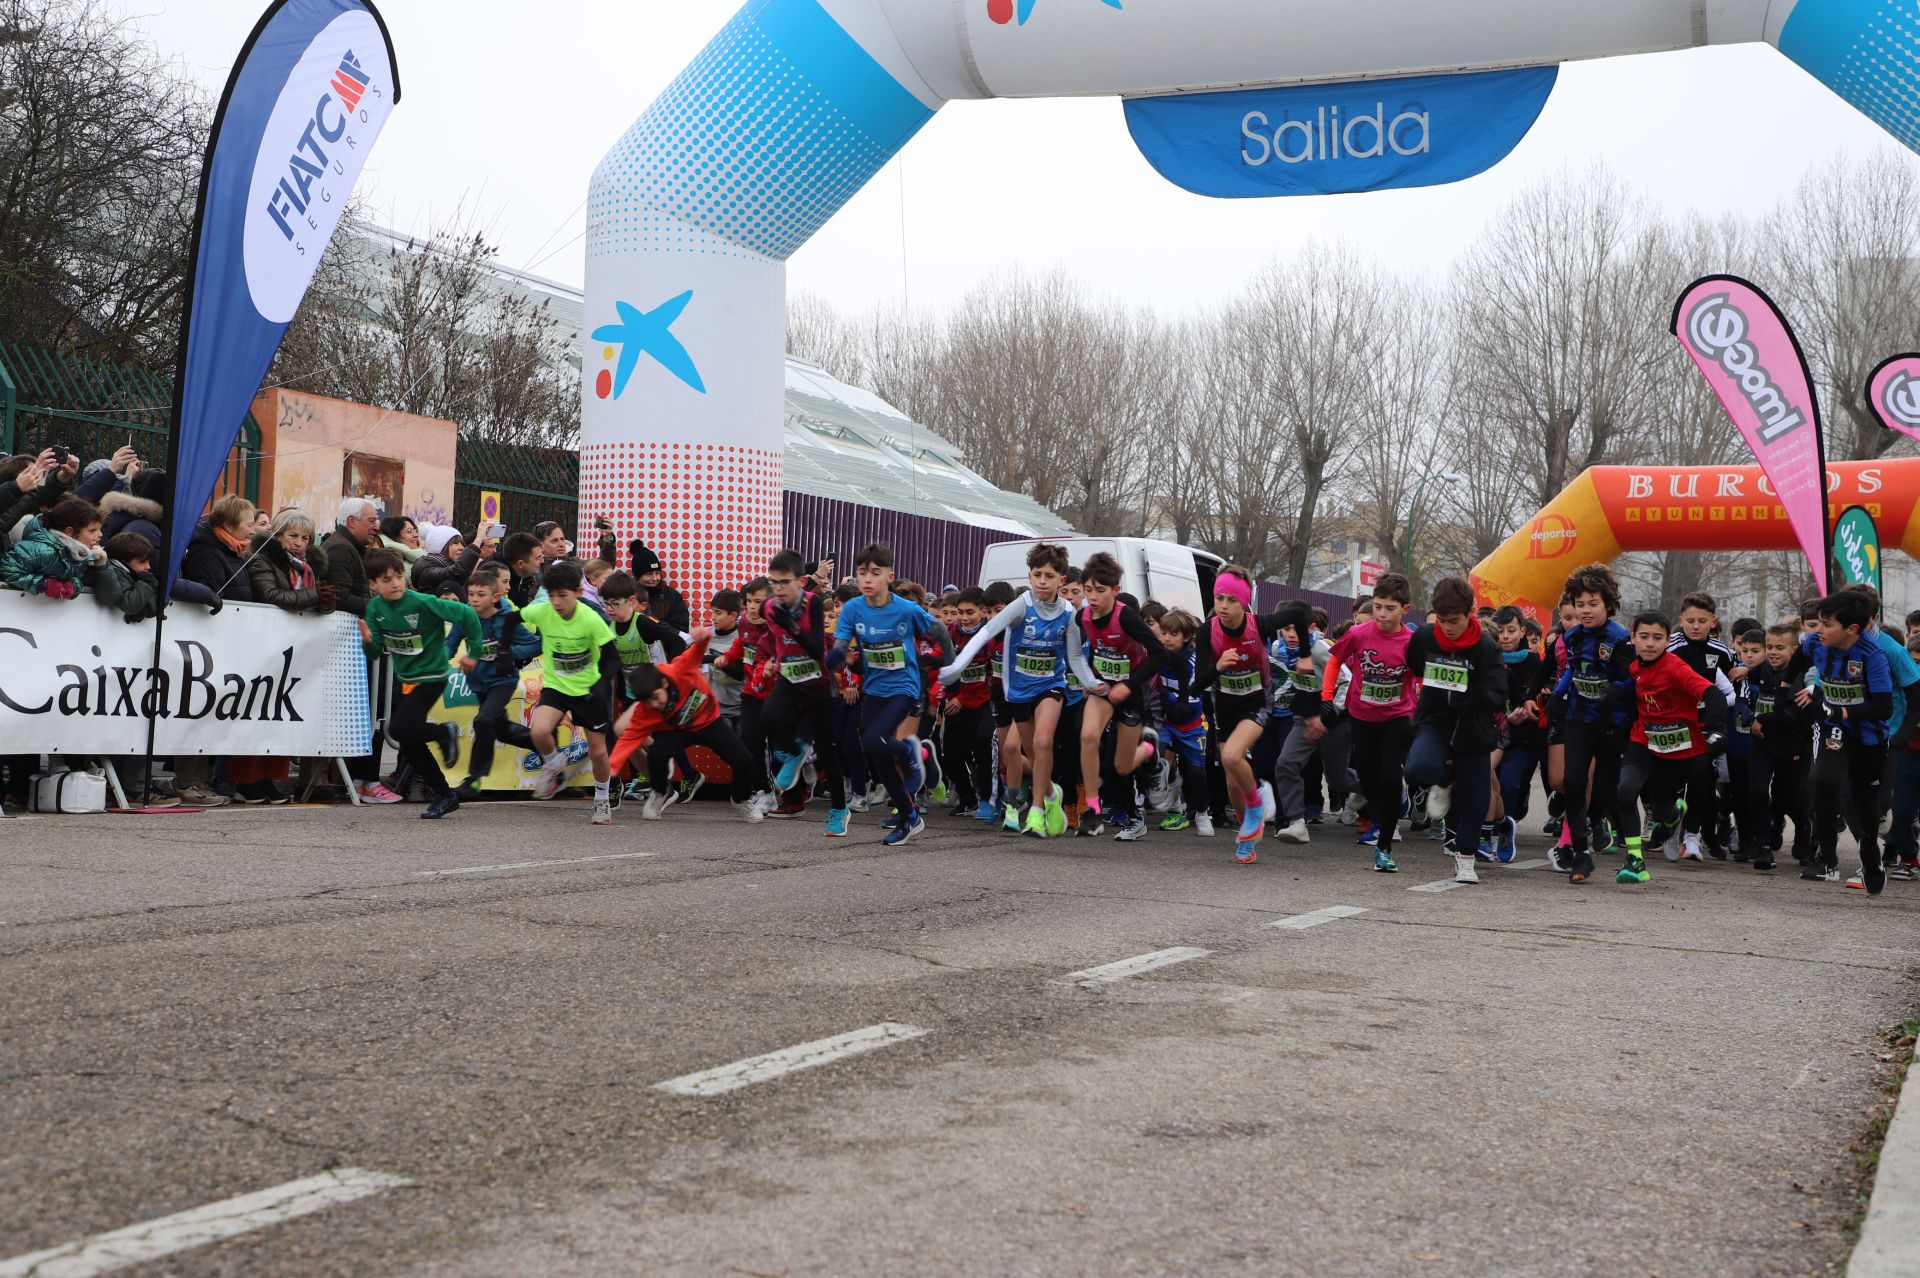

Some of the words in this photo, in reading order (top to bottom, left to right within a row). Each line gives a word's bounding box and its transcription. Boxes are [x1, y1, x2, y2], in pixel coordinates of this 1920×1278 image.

[1241, 102, 1429, 166] Salida
[297, 85, 381, 256] SEGUROS
[1627, 505, 1879, 520] AYUNTAMIO
[1531, 528, 1577, 541] deportes
[393, 639, 414, 649] 994
[873, 651, 895, 663] 969
[787, 663, 815, 677] 1009
[1023, 659, 1051, 671] 1029
[1102, 661, 1120, 674] 989
[1433, 668, 1464, 683] 1037
[1228, 677, 1251, 689] 960
[1370, 686, 1398, 698] 1058
[1824, 686, 1856, 699] 1086
[1653, 733, 1684, 746] 1094
